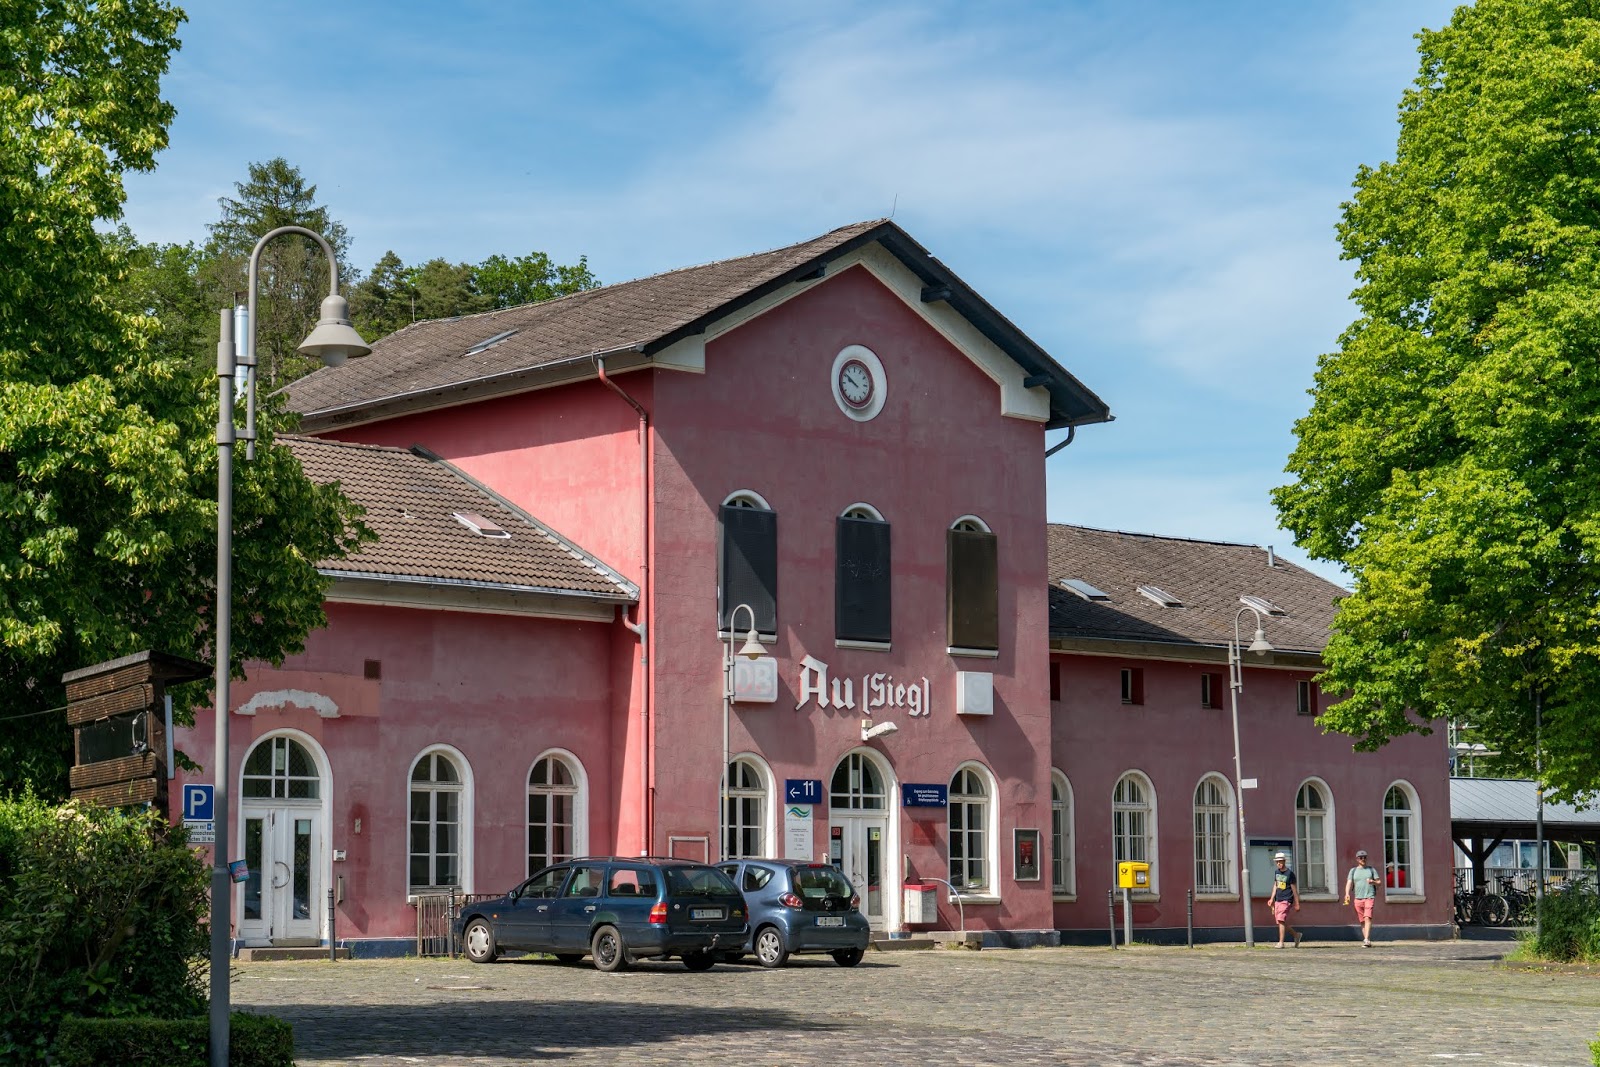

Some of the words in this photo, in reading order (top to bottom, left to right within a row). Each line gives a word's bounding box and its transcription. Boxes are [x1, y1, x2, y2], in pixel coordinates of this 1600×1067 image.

[795, 654, 856, 711] Au
[803, 780, 814, 796] 11
[190, 789, 207, 816] P
